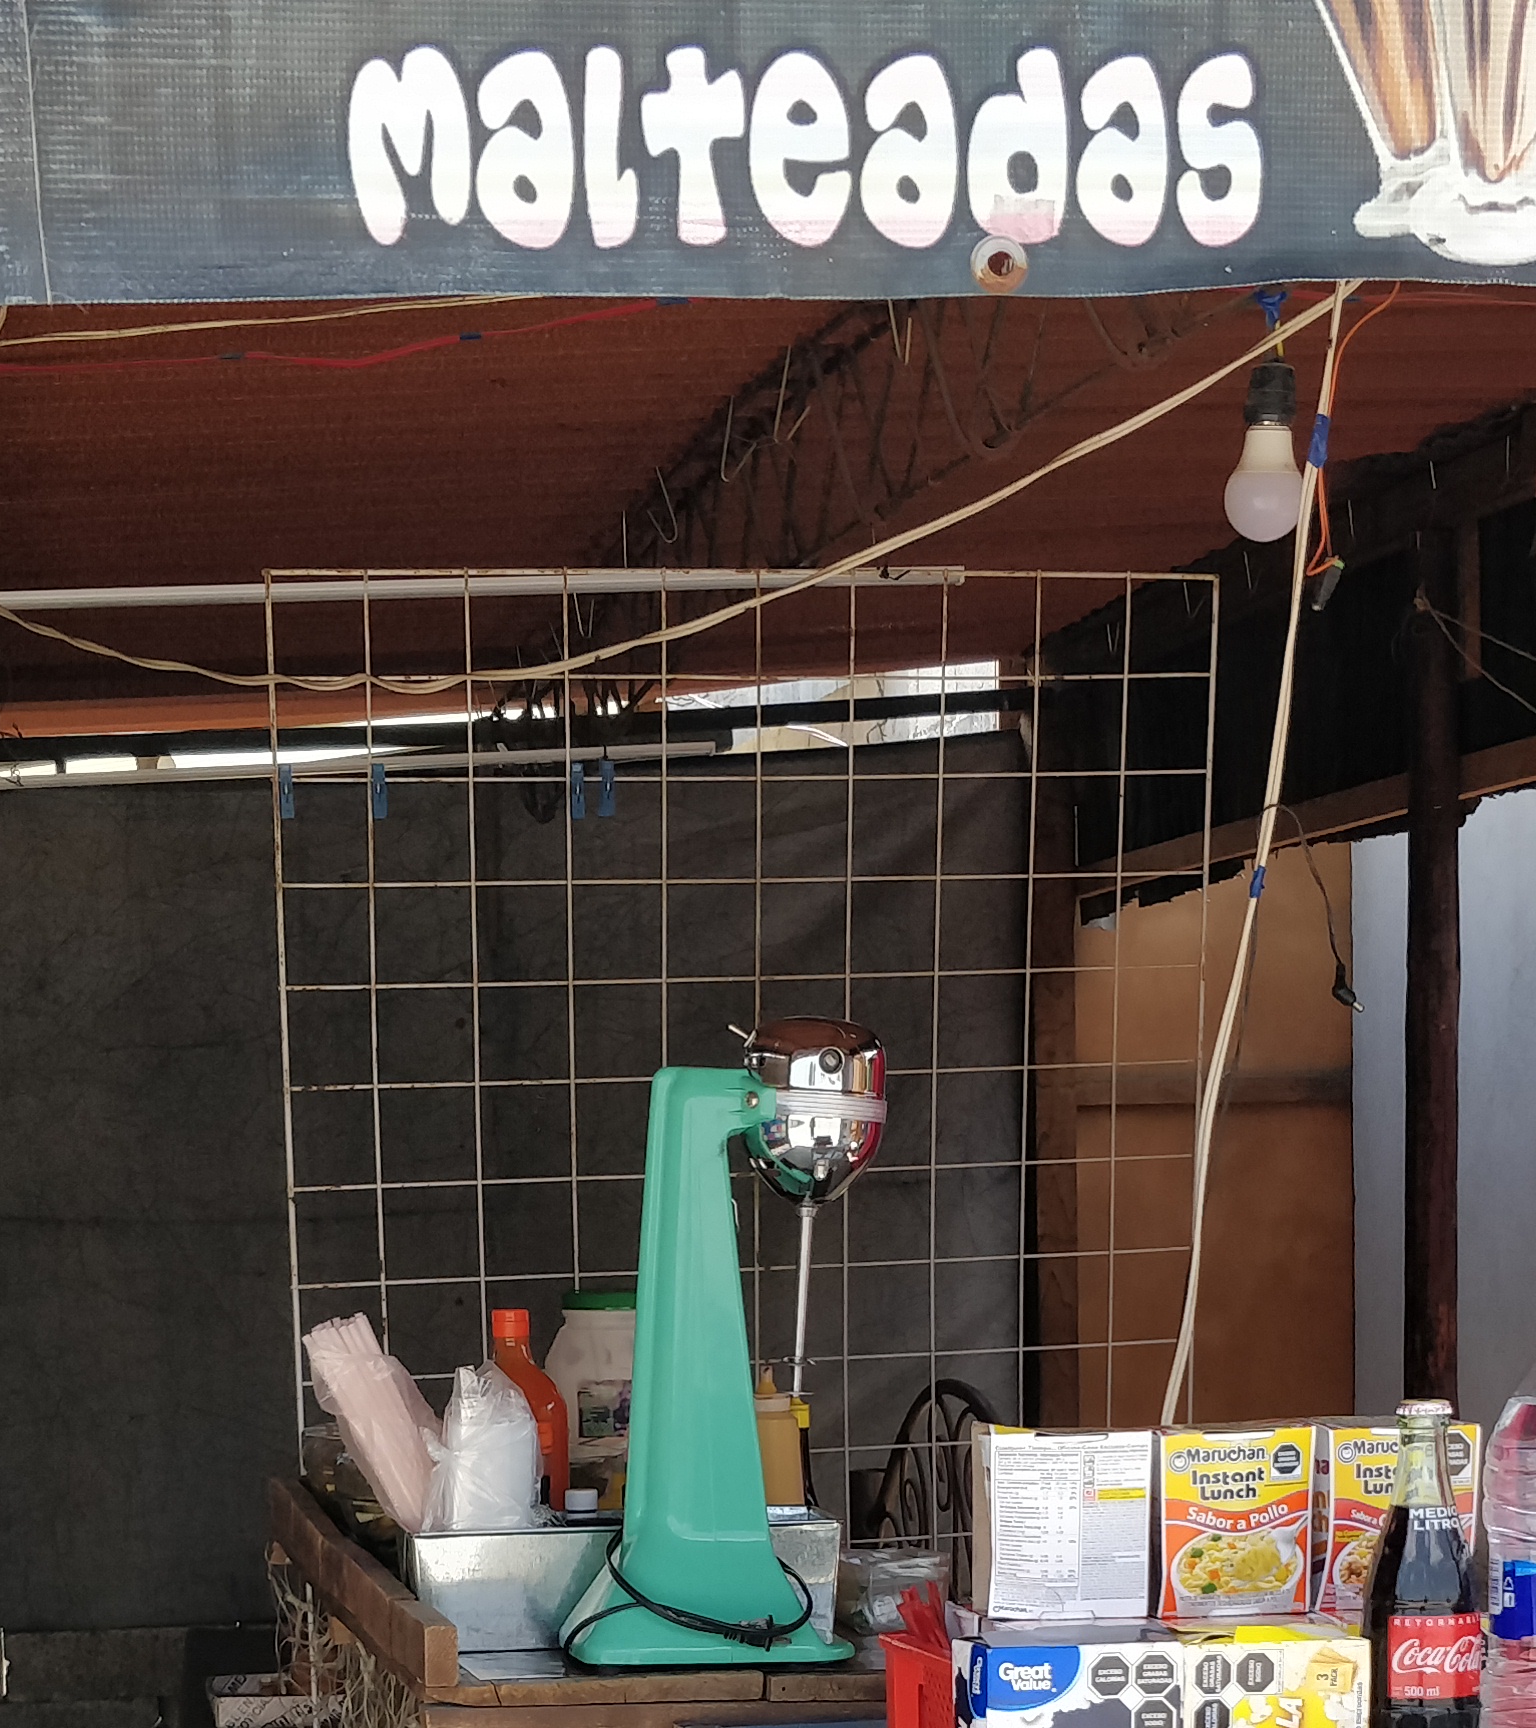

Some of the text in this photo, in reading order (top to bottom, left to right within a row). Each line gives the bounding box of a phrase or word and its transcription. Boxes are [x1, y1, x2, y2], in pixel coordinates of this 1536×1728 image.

[348, 45, 1264, 250] Malteadas
[1186, 1444, 1268, 1465] Maruchan
[1352, 1440, 1400, 1455] Maruc
[1191, 1466, 1266, 1486] Instant
[1355, 1462, 1397, 1479] Inst
[1199, 1483, 1258, 1501] Lunch
[1362, 1479, 1394, 1495] Lun
[1186, 1503, 1289, 1531] Sabor a Pollo
[1408, 1505, 1459, 1519] MEDIO
[1413, 1517, 1461, 1532] LITRO
[1390, 1634, 1482, 1675] Coca-Cola
[997, 1661, 1053, 1681] Great
[1316, 1672, 1329, 1681] 3
[1329, 1668, 1339, 1687] PACK
[1010, 1678, 1053, 1692] Value
[1404, 1685, 1424, 1698] 500
[1426, 1685, 1441, 1697] ml
